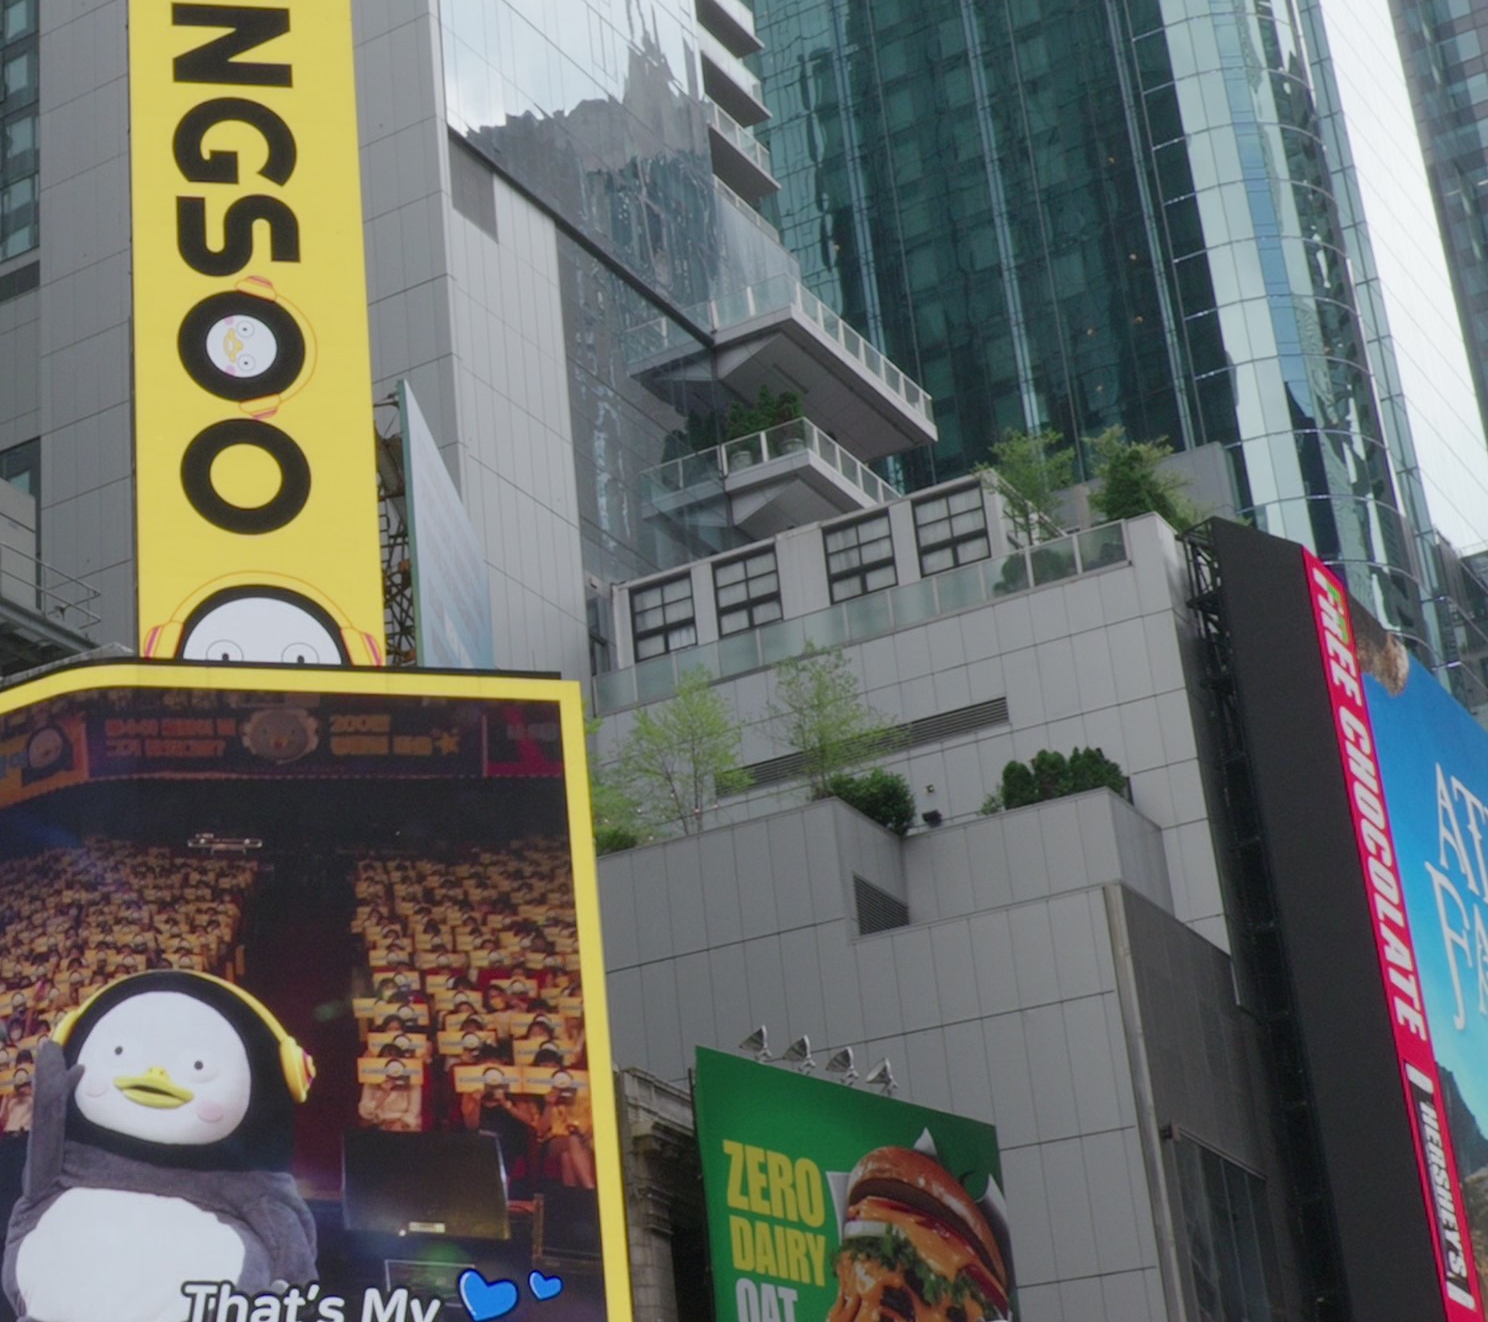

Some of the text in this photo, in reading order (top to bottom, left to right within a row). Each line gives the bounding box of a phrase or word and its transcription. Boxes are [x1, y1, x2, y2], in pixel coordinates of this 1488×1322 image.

[1339, 711, 1429, 1043] CHOCOLATE
[1420, 1100, 1469, 1282] HERSHEY'S
[723, 1139, 825, 1228] ZERO
[729, 1215, 827, 1288] DAIRY
